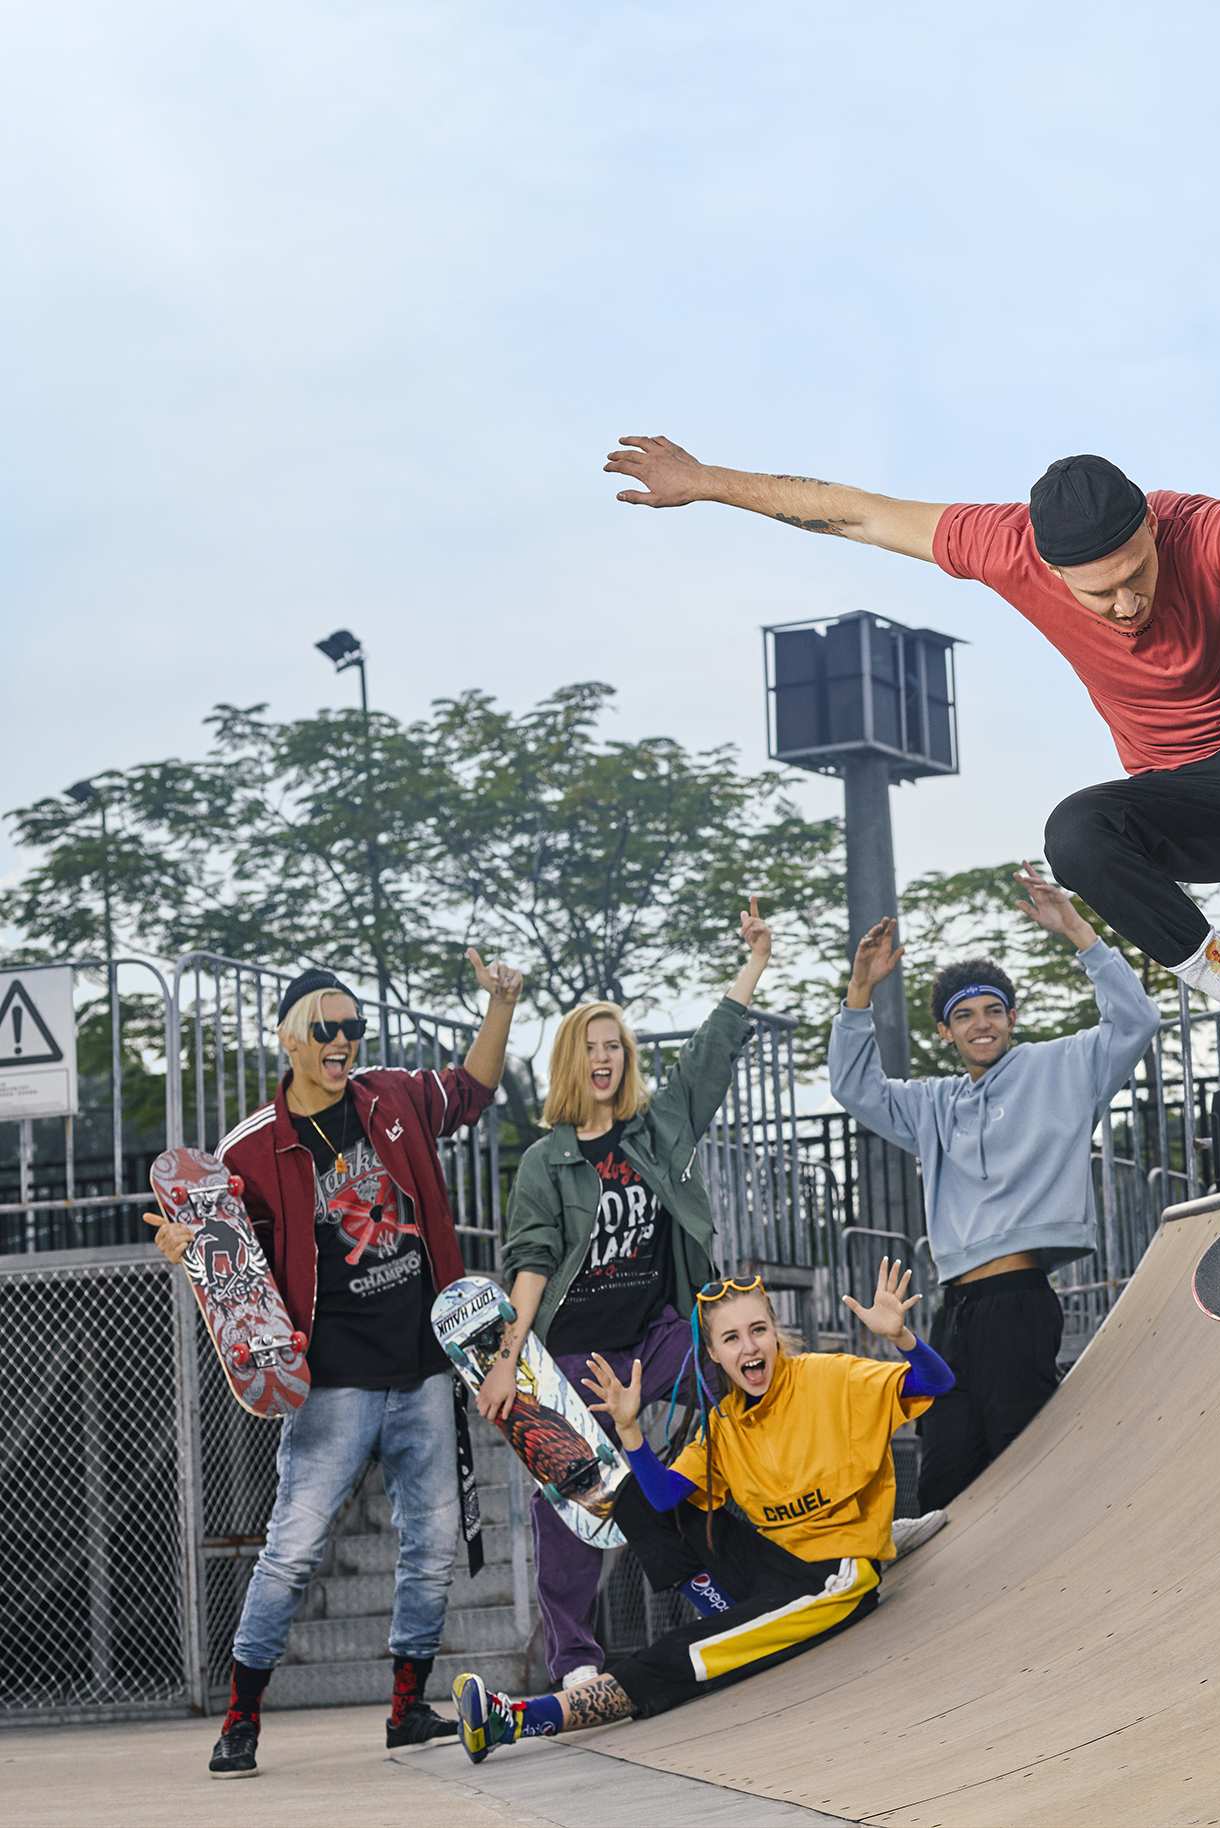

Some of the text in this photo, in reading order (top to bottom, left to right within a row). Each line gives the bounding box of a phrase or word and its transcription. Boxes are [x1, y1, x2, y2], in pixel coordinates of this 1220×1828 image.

[435, 1286, 497, 1338] TONY HAWK
[762, 1488, 832, 1522] CRUEL
